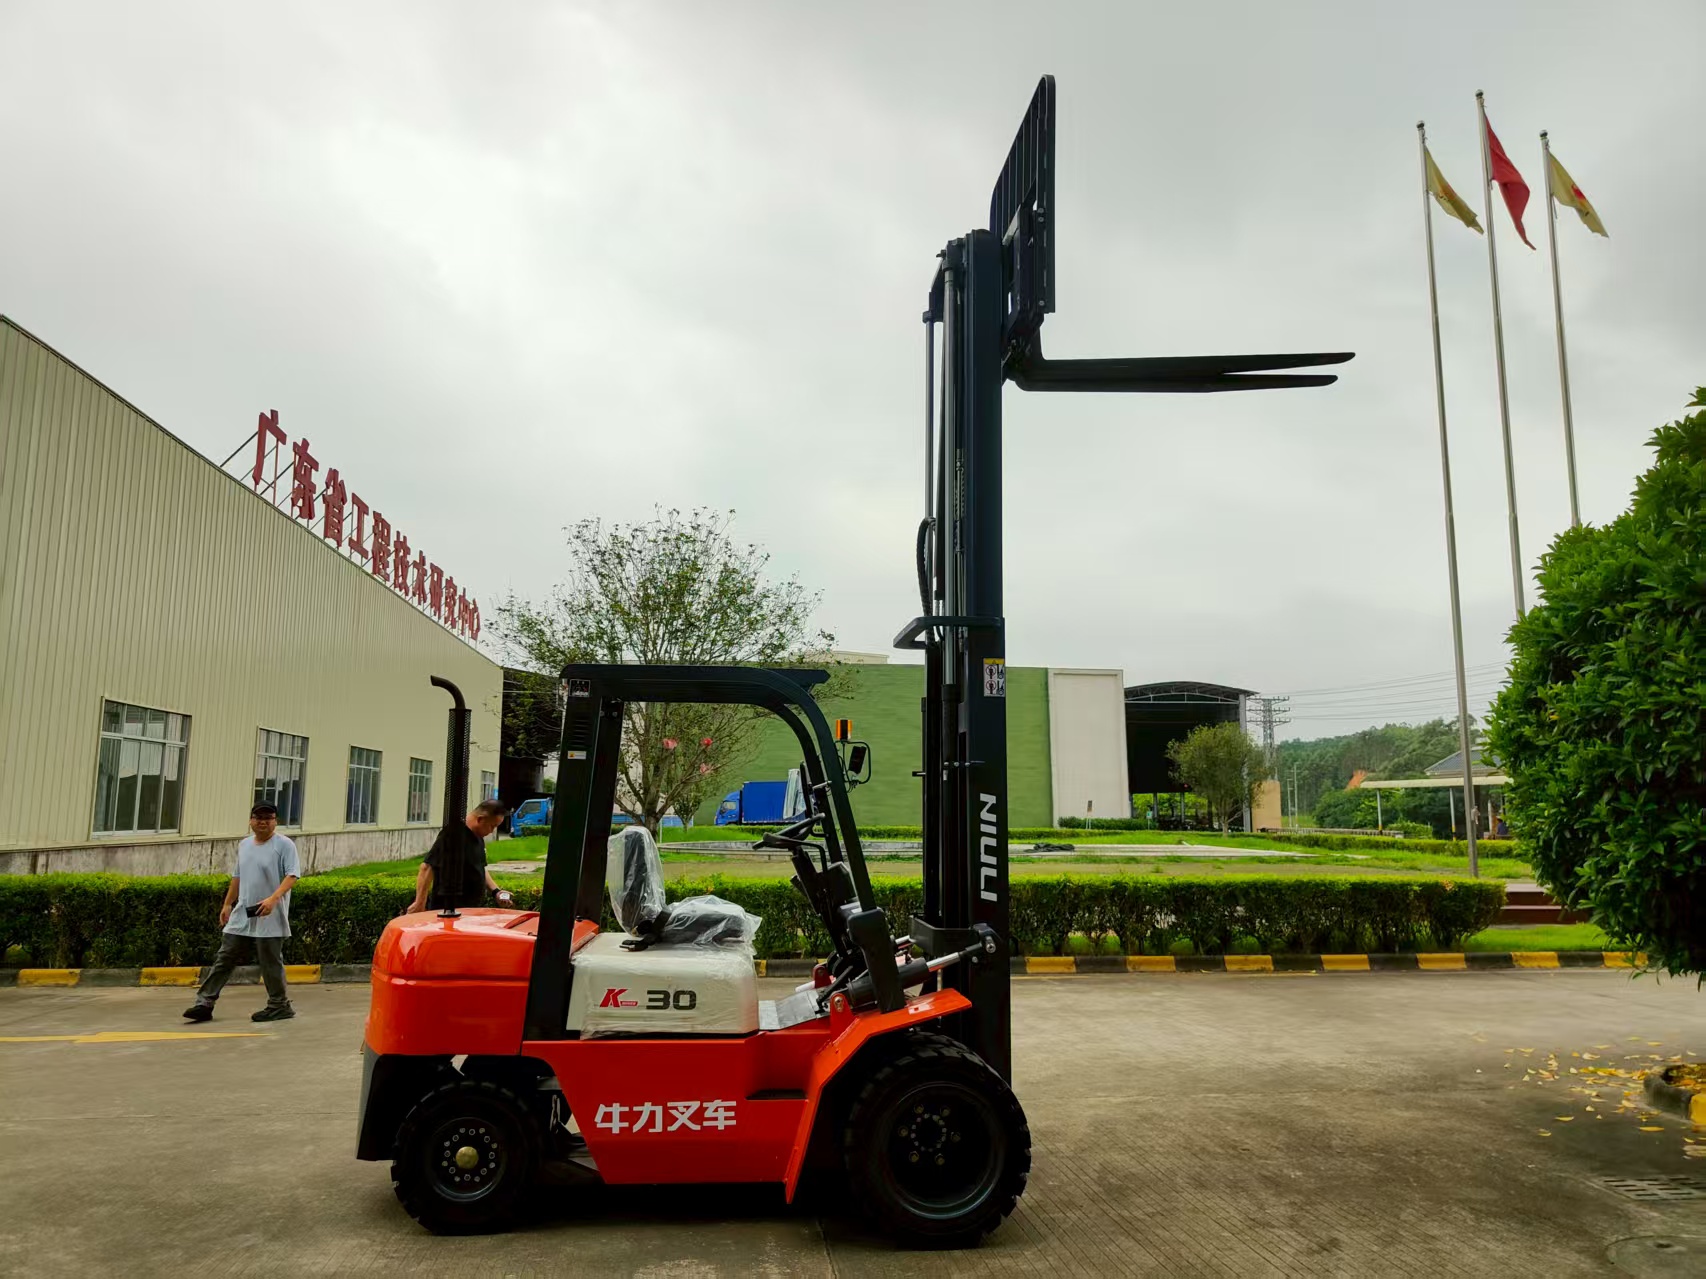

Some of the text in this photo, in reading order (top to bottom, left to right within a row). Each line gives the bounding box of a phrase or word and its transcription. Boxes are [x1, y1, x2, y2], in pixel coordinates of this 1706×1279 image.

[599, 988, 697, 1010] K 30
[594, 1099, 737, 1134] 牛力叉车
